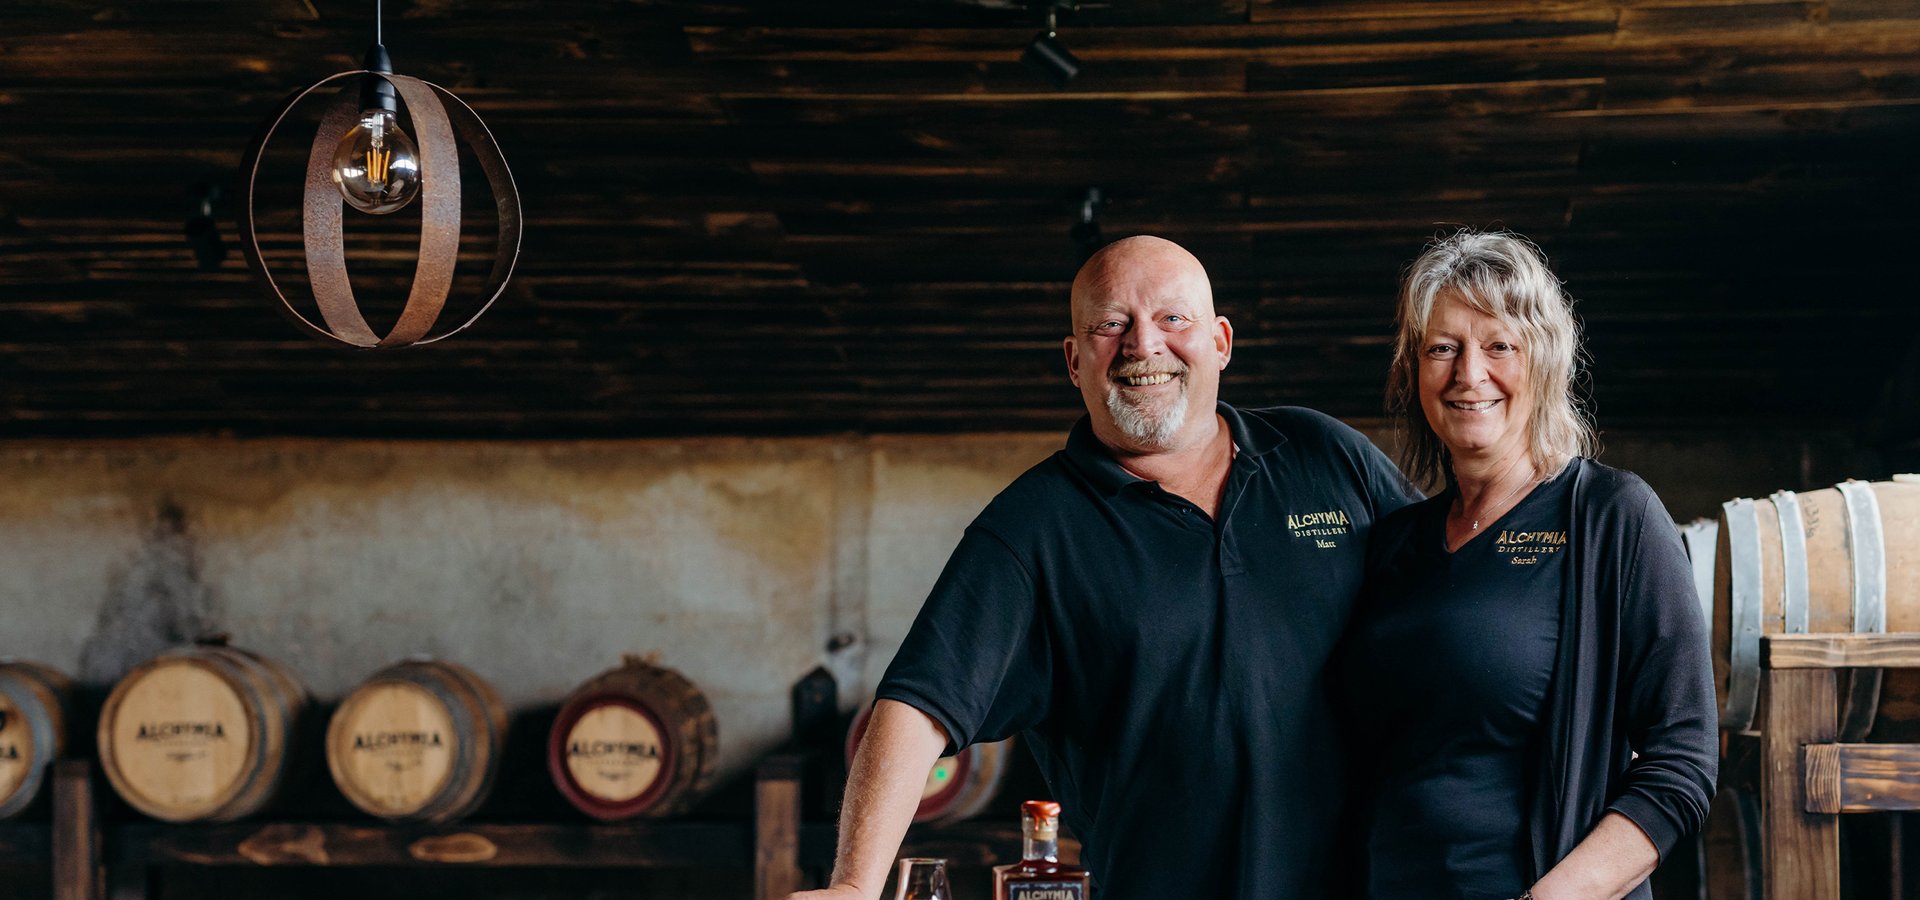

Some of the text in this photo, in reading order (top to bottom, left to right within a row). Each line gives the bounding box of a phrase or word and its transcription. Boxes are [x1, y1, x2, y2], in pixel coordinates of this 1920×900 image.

[1288, 510, 1349, 529] ALCHYMIA
[1294, 527, 1347, 537] DISTILLERY
[1496, 530, 1567, 545] ALCHYMIA
[1511, 555, 1538, 566] Sarah
[1017, 889, 1075, 900] ALCHYMIA
